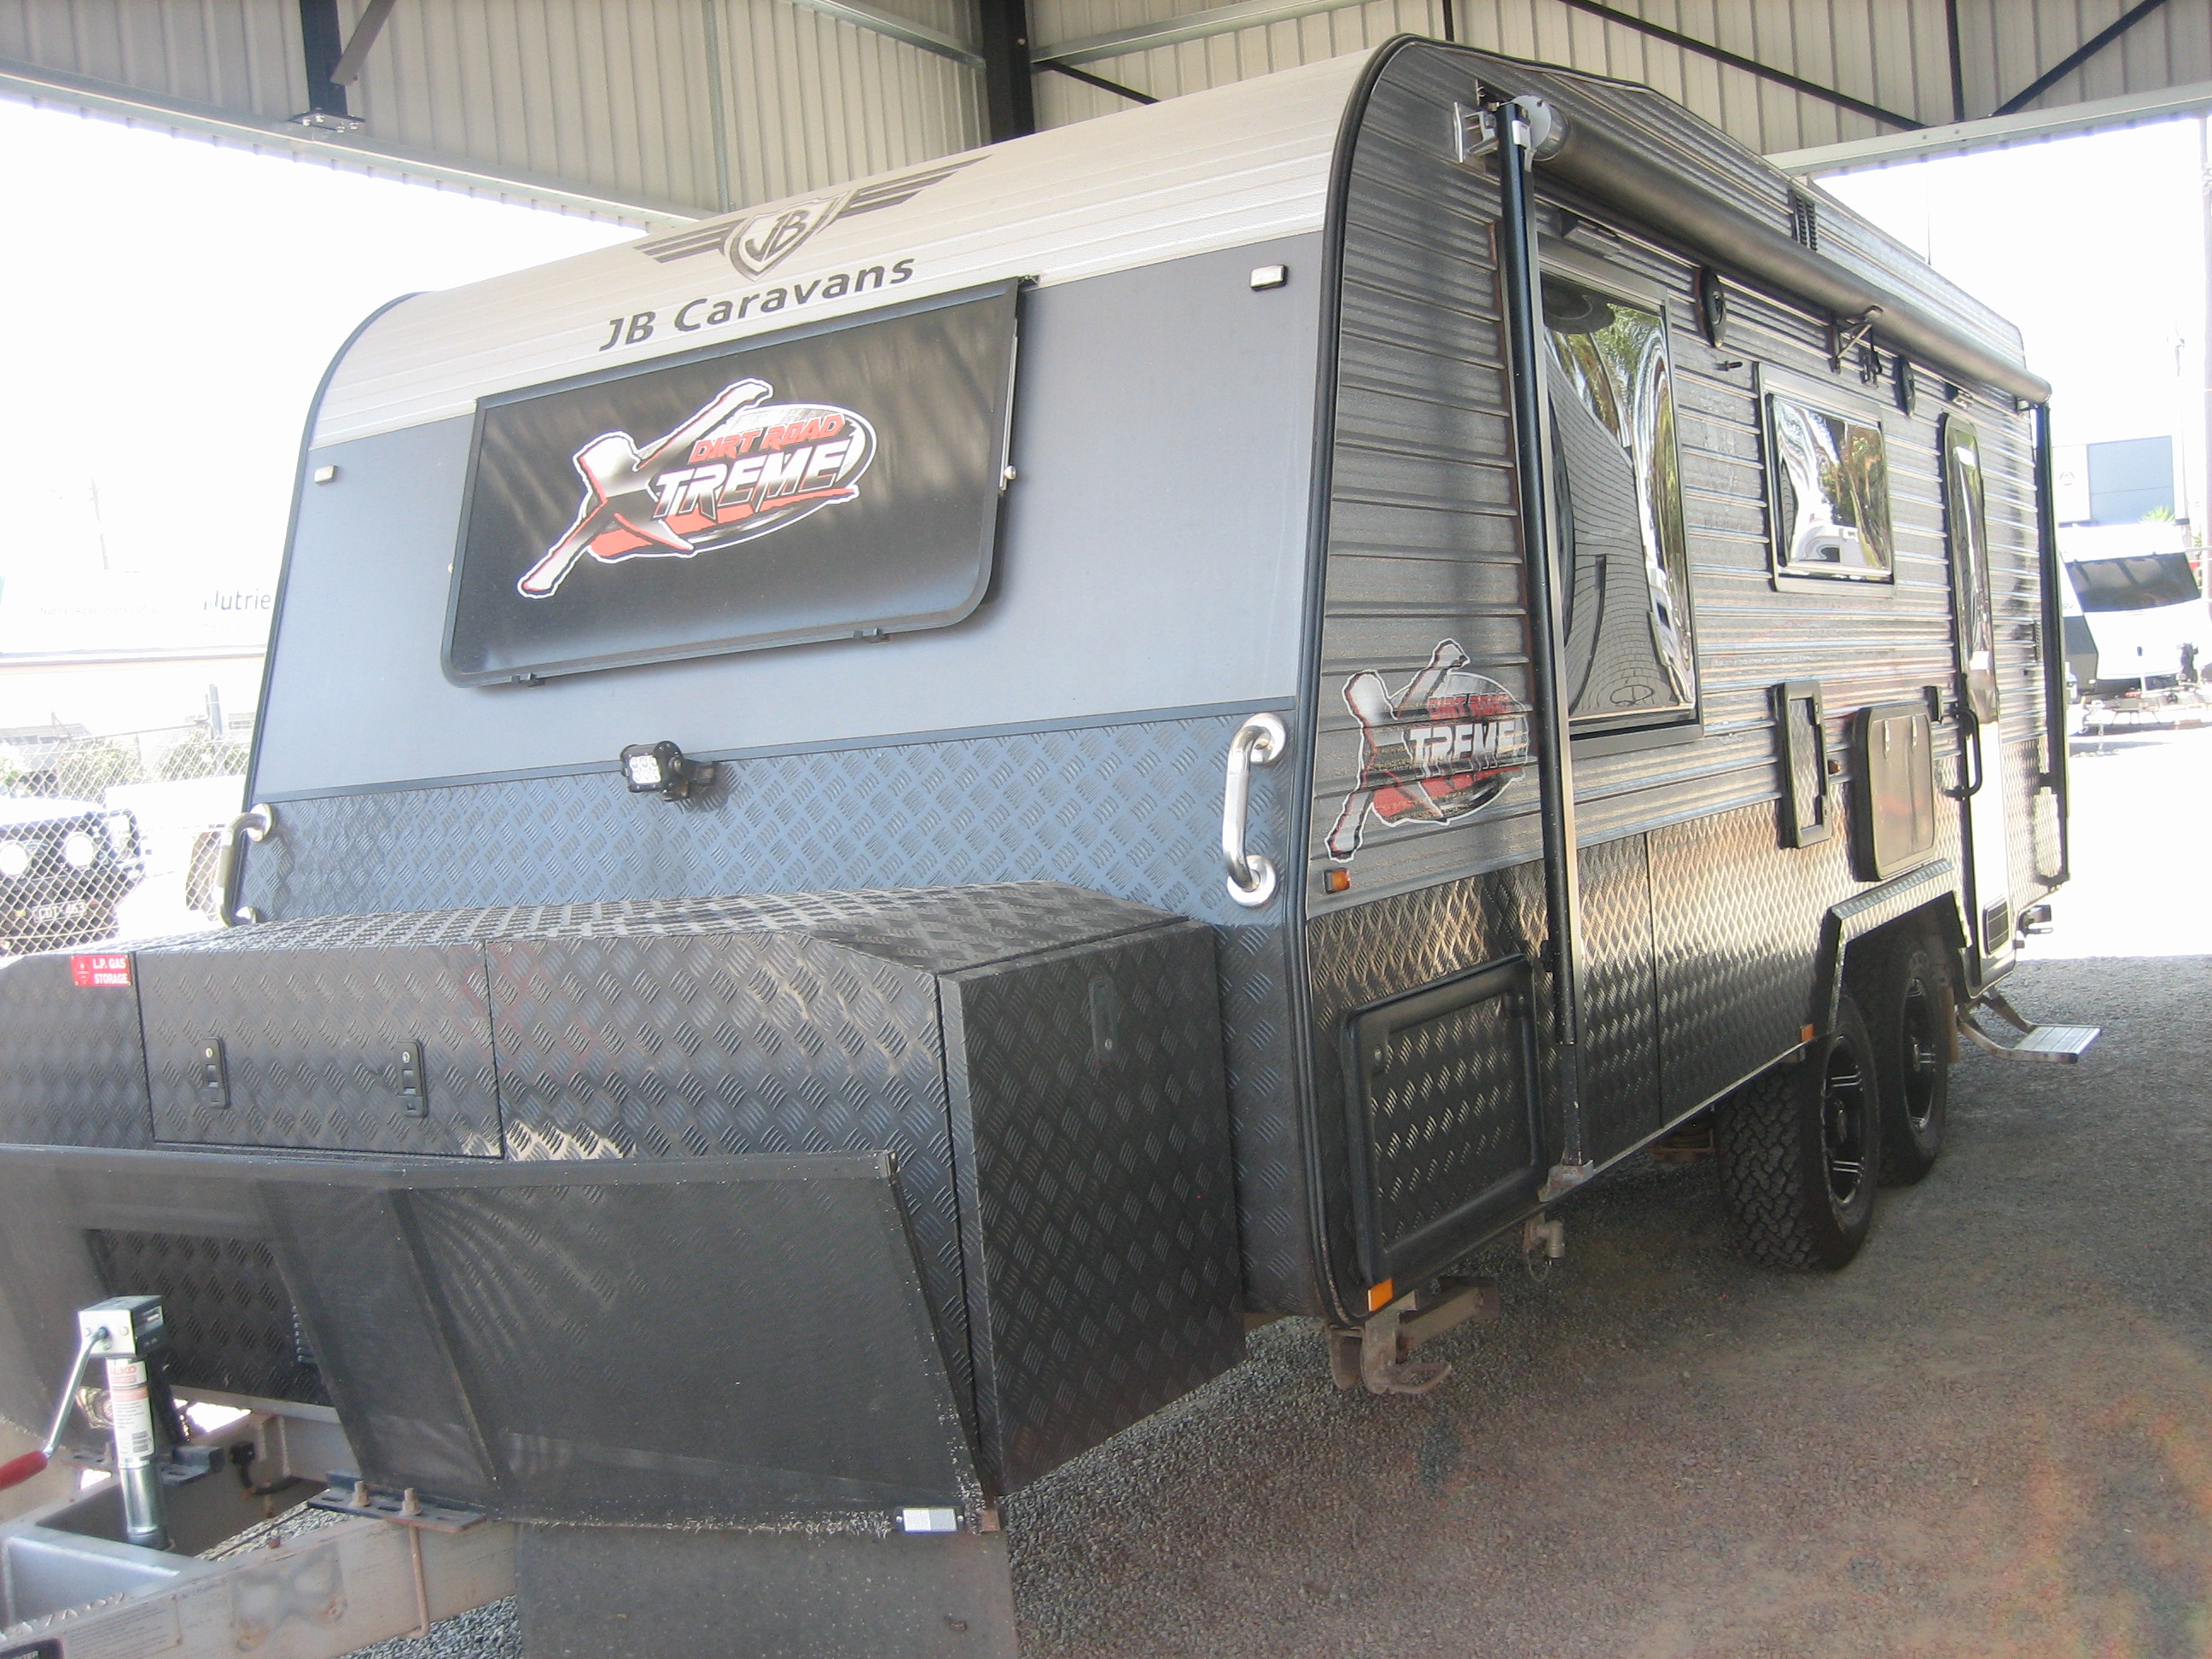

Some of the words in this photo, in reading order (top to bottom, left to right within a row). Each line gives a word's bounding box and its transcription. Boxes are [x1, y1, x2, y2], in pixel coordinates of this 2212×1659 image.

[744, 208, 811, 262] JB
[598, 311, 655, 352] JB
[674, 259, 916, 333] Caravans
[688, 429, 761, 464] DIRT
[761, 412, 845, 451] ROAD
[203, 588, 271, 611] Nutrie
[93, 958, 108, 969] L.P.
[108, 958, 127, 969] GAS
[94, 973, 129, 985] STORAGE
